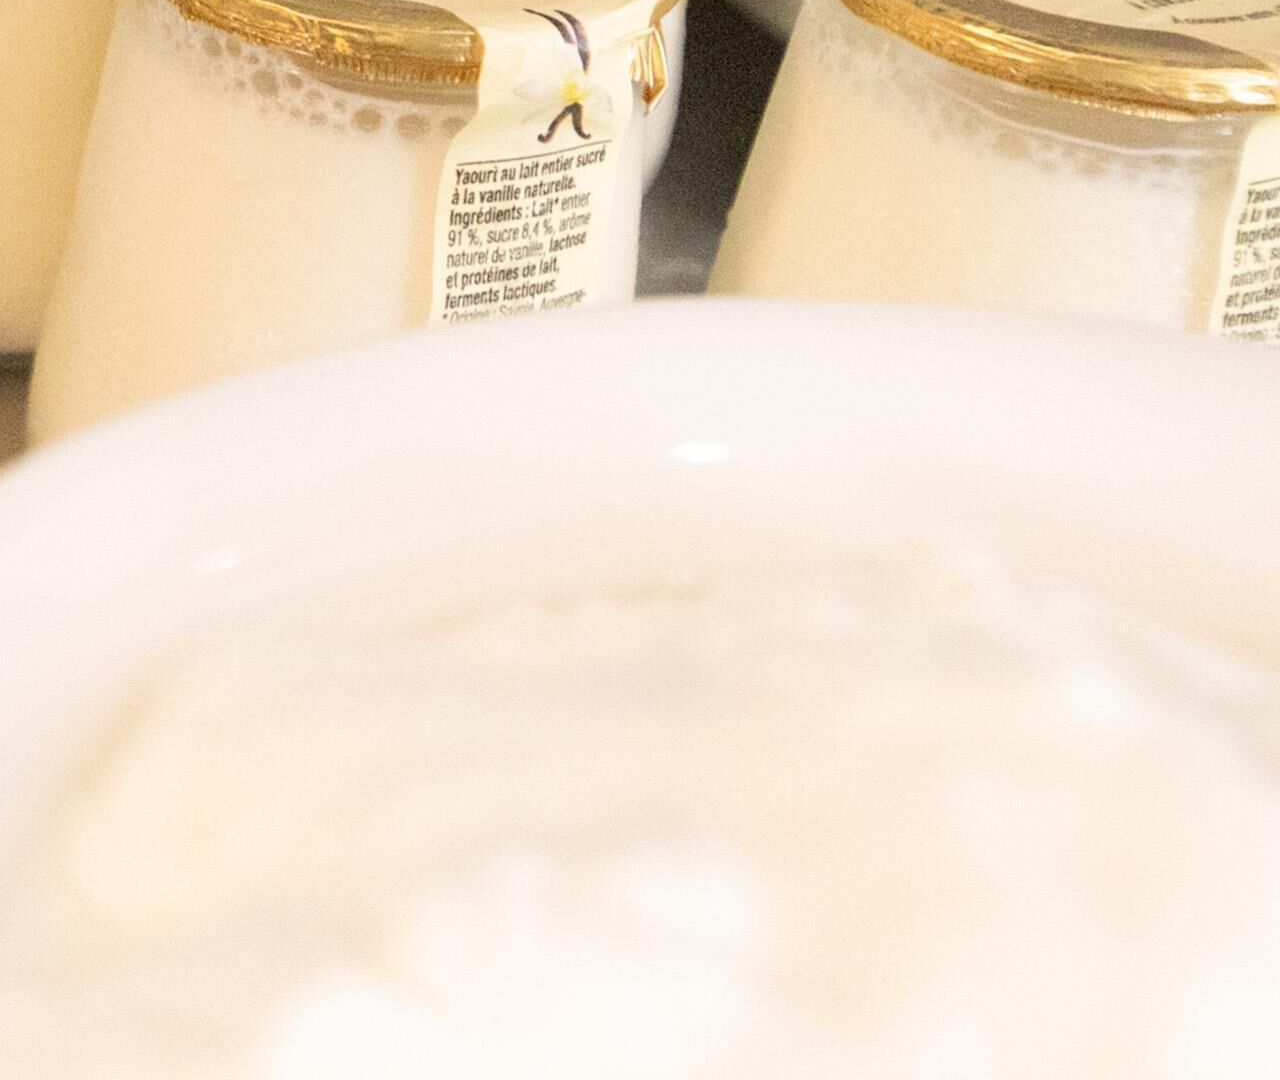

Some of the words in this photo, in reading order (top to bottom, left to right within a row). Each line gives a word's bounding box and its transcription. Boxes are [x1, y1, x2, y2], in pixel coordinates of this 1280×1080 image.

[456, 166, 498, 186] Yaourt
[501, 168, 516, 182] au
[519, 160, 539, 178] lait
[541, 156, 574, 176] entier
[576, 145, 607, 168] sucré
[451, 187, 460, 205] à
[463, 189, 476, 204] la
[480, 183, 521, 204] vanille
[524, 175, 577, 199] naturelle.
[449, 204, 522, 230] Ingrédients
[561, 193, 591, 211] entier
[447, 229, 463, 248] 91
[486, 224, 519, 245] sucre
[521, 221, 540, 241] 8,4
[559, 212, 591, 233] arôme
[446, 248, 489, 269] naturel
[491, 247, 506, 263] de
[509, 242, 546, 262] vanille,
[549, 231, 587, 252] lactose
[446, 272, 458, 289] et
[461, 265, 520, 291] protéines
[522, 263, 536, 278] de
[539, 257, 560, 276] lait,
[1231, 267, 1271, 288] naturel
[445, 287, 500, 310] ferments
